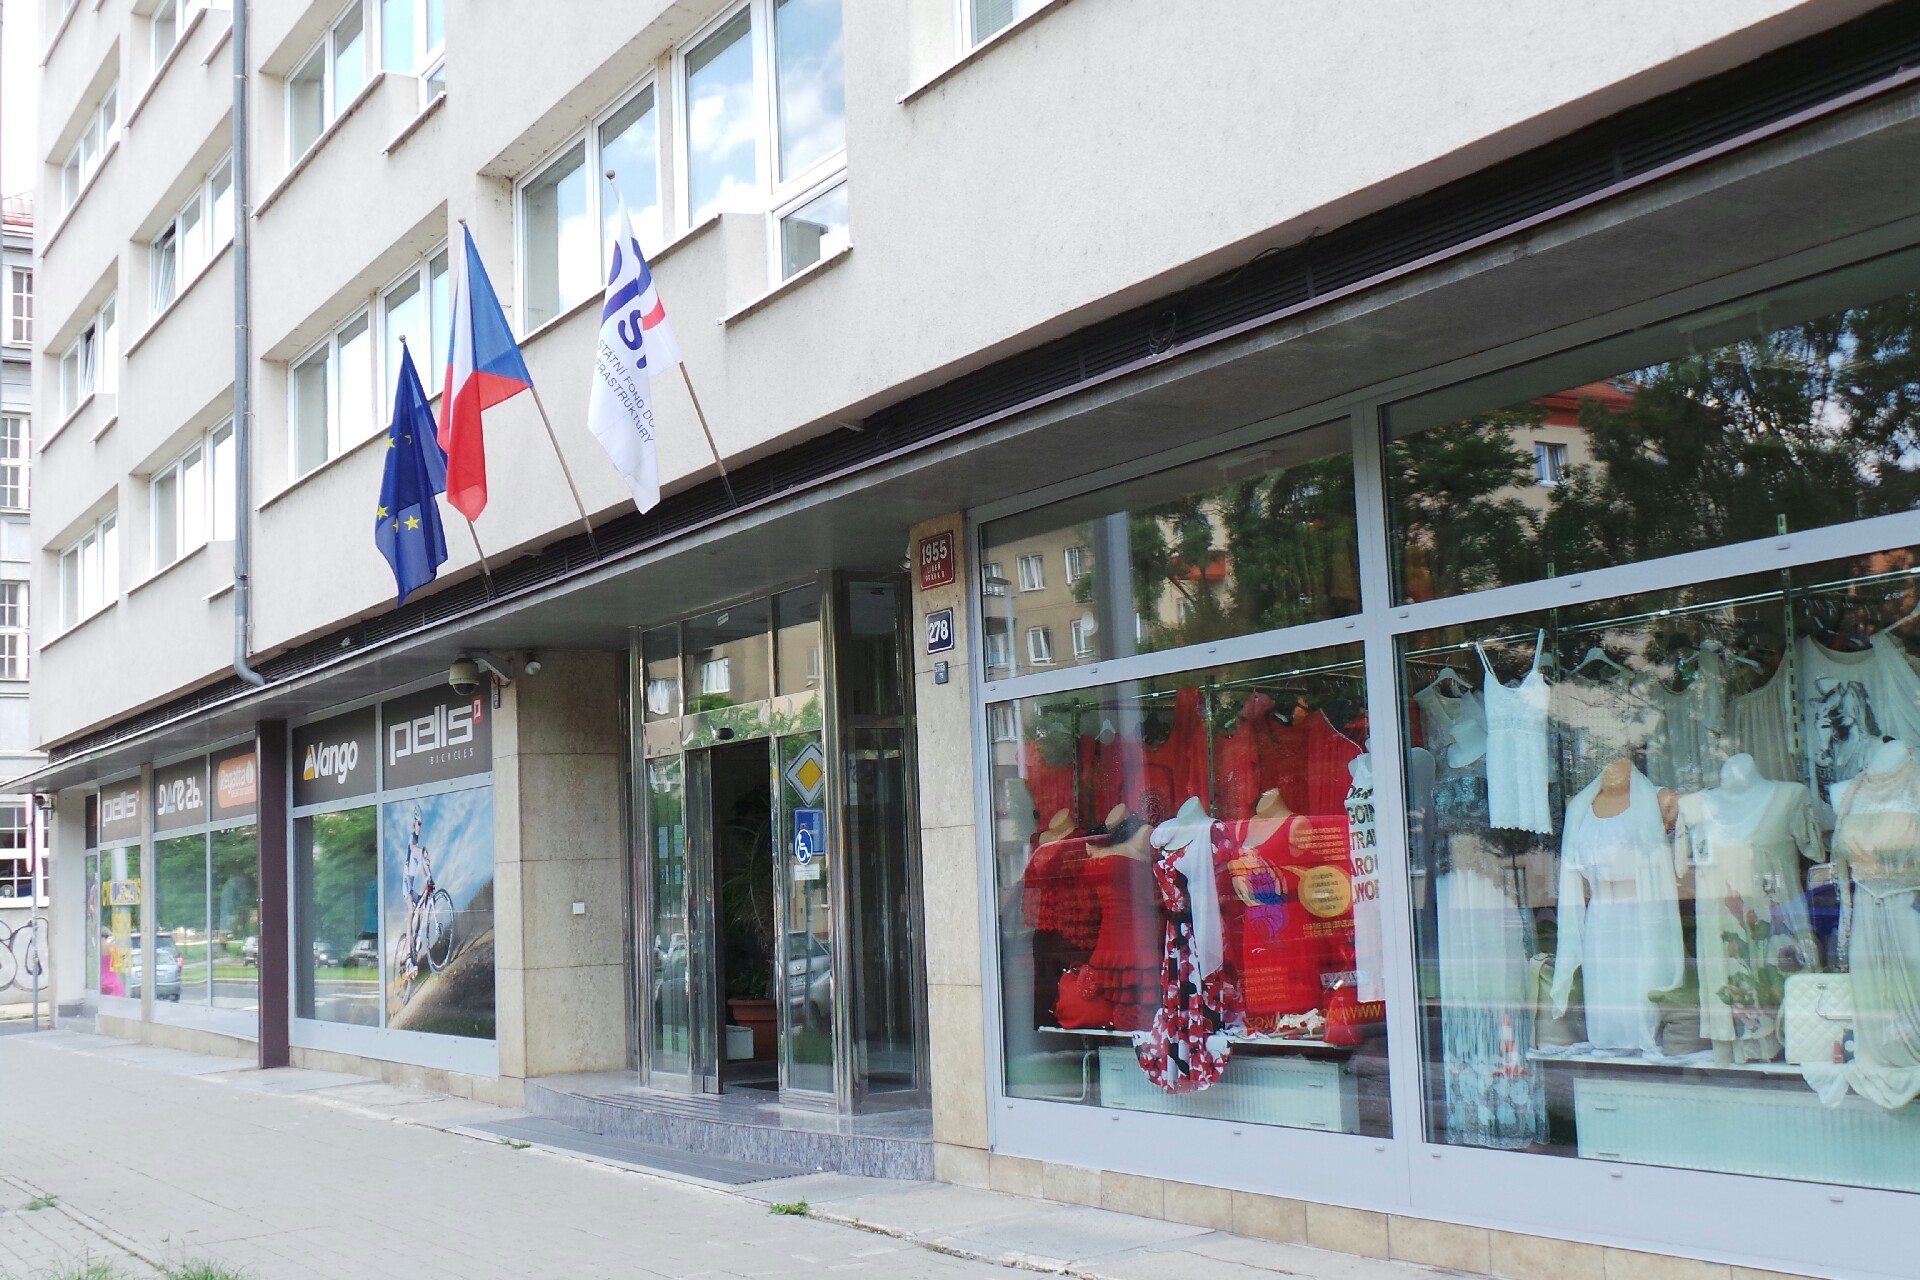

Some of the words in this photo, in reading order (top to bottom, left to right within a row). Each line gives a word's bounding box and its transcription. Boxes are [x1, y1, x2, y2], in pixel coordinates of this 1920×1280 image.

[597, 339, 628, 375] STÁTNÍ
[623, 375, 644, 409] FOND
[921, 540, 948, 566] 1955
[928, 619, 949, 644] 278
[311, 740, 359, 785] Vango
[430, 747, 474, 765] BICYCLES
[220, 765, 247, 795] Regatta
